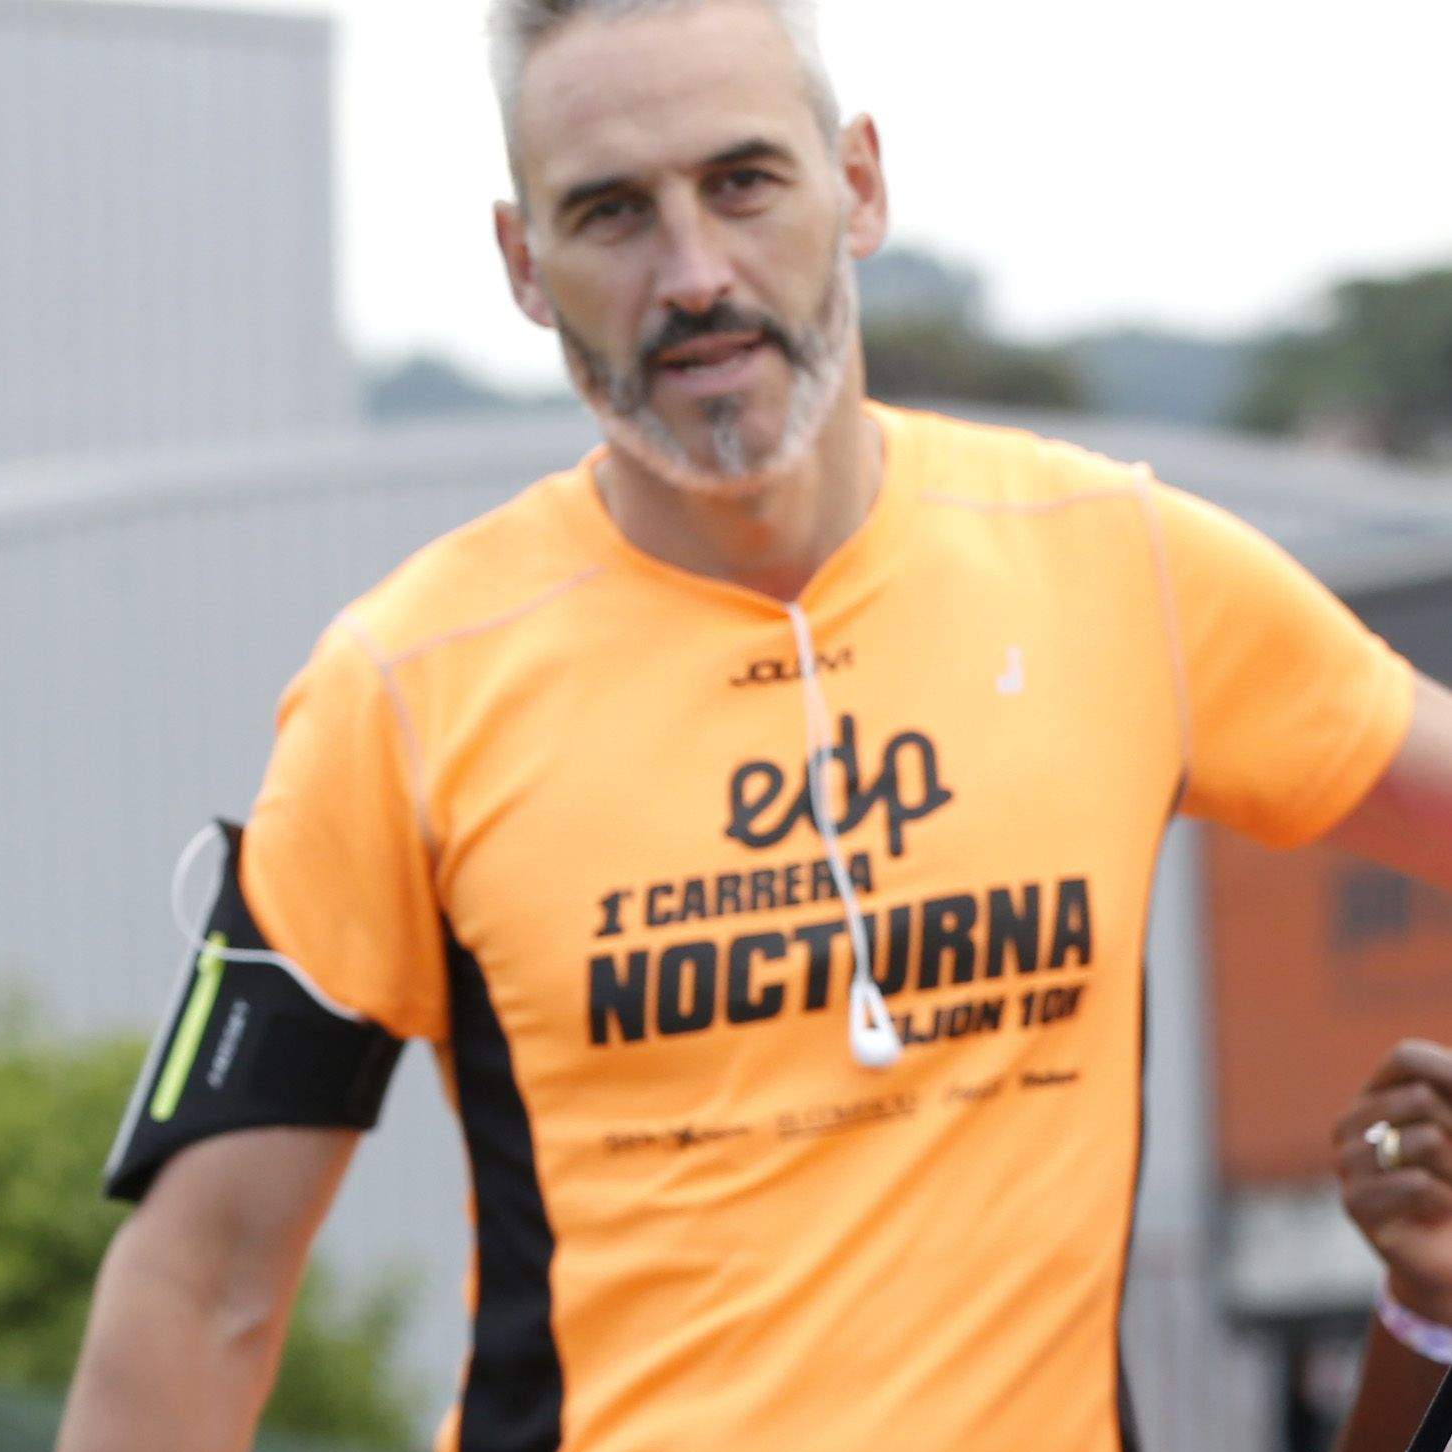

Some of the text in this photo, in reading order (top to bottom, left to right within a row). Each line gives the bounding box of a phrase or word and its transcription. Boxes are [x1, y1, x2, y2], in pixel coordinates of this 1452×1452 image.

[726, 713, 953, 857] edp
[646, 853, 872, 926] CARRERA
[588, 876, 1093, 1046] NOCTURNA
[897, 994, 1005, 1048] IJON
